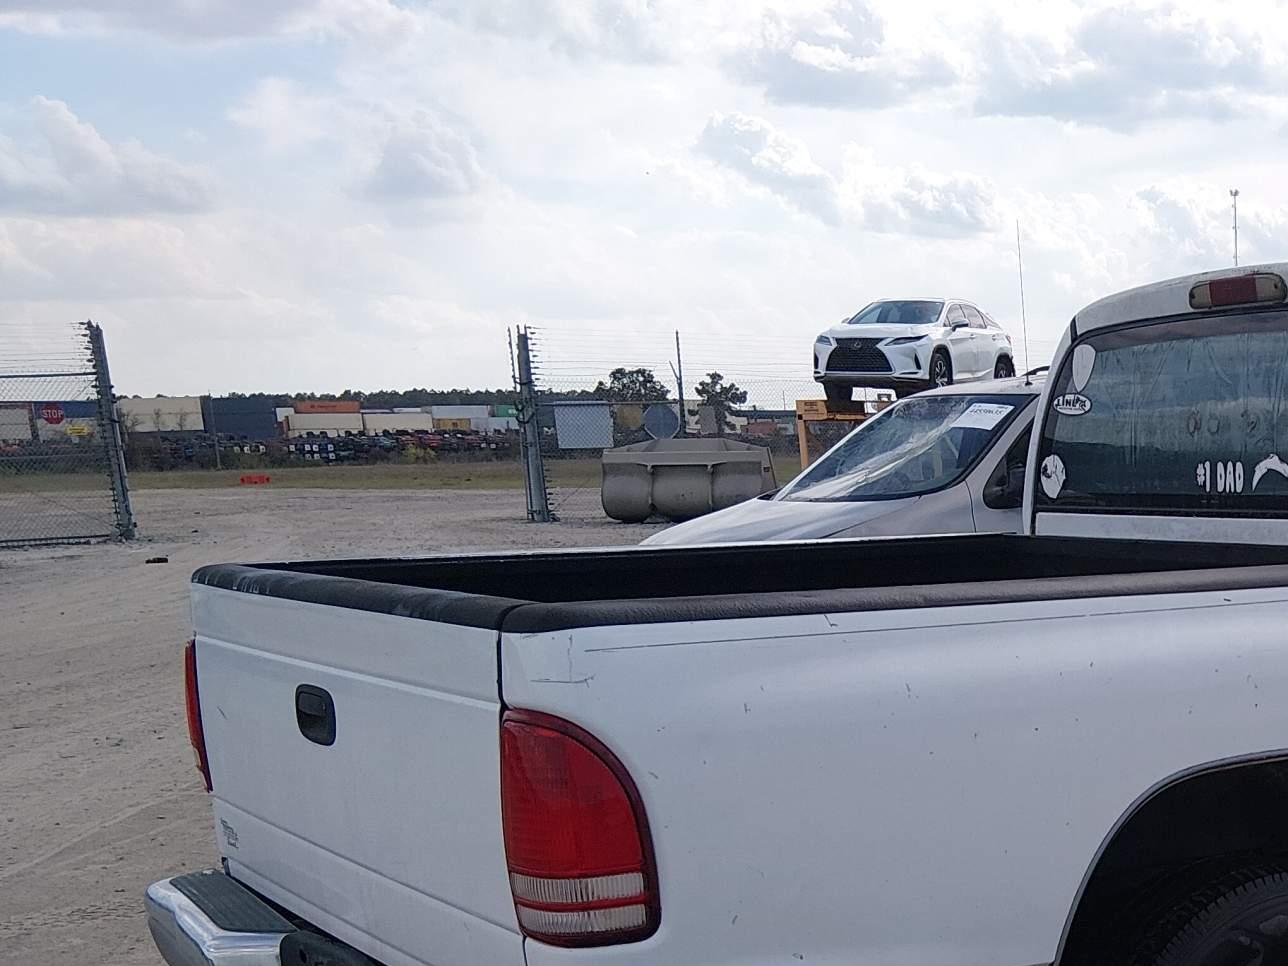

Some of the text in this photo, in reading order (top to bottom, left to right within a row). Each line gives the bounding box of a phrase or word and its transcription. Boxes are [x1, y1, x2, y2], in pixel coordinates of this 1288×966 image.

[42, 409, 64, 418] STOP
[1196, 461, 1244, 493] #1 DAD
